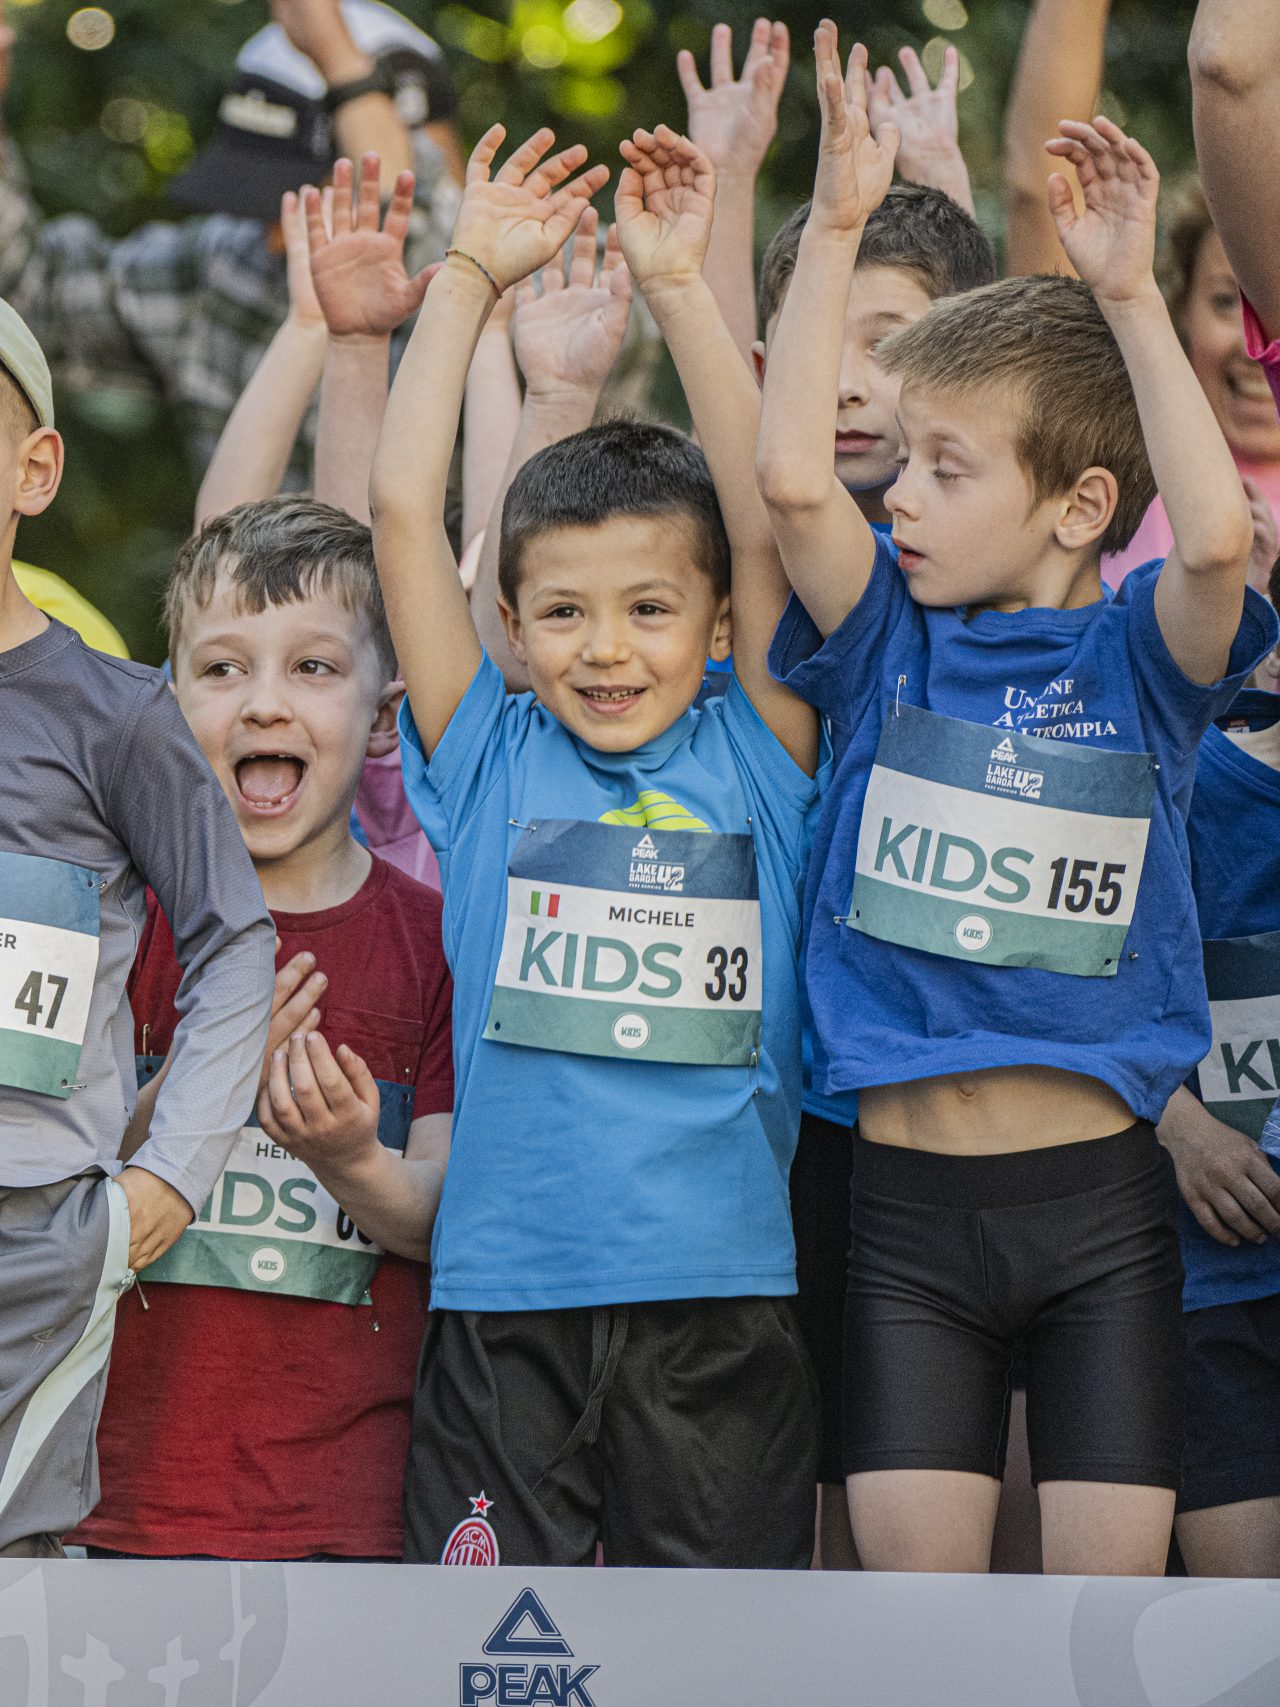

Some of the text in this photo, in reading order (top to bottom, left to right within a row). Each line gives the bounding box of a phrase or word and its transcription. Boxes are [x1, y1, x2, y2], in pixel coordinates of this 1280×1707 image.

[1004, 679, 1074, 709] UNNE
[1008, 720, 1118, 739] TROMPIA
[991, 749, 1019, 764] PEAK
[985, 774, 1013, 788] GARDA
[987, 764, 1015, 779] LAKE
[632, 847, 659, 860] PEAK
[630, 862, 658, 876] LAKE
[874, 816, 1126, 916] KIDS 155
[629, 872, 656, 884] GARDA
[608, 906, 695, 928] MICHELE
[963, 928, 984, 940] KIDS
[518, 927, 749, 1001] KIDS 33
[14, 970, 69, 1030] 47
[621, 1026, 641, 1037] KIDS
[1220, 1039, 1280, 1093] KI
[198, 1170, 318, 1233] DS
[257, 1260, 278, 1270] KIDS
[460, 1530, 487, 1550] ACM
[459, 1662, 602, 1707] PEAK
